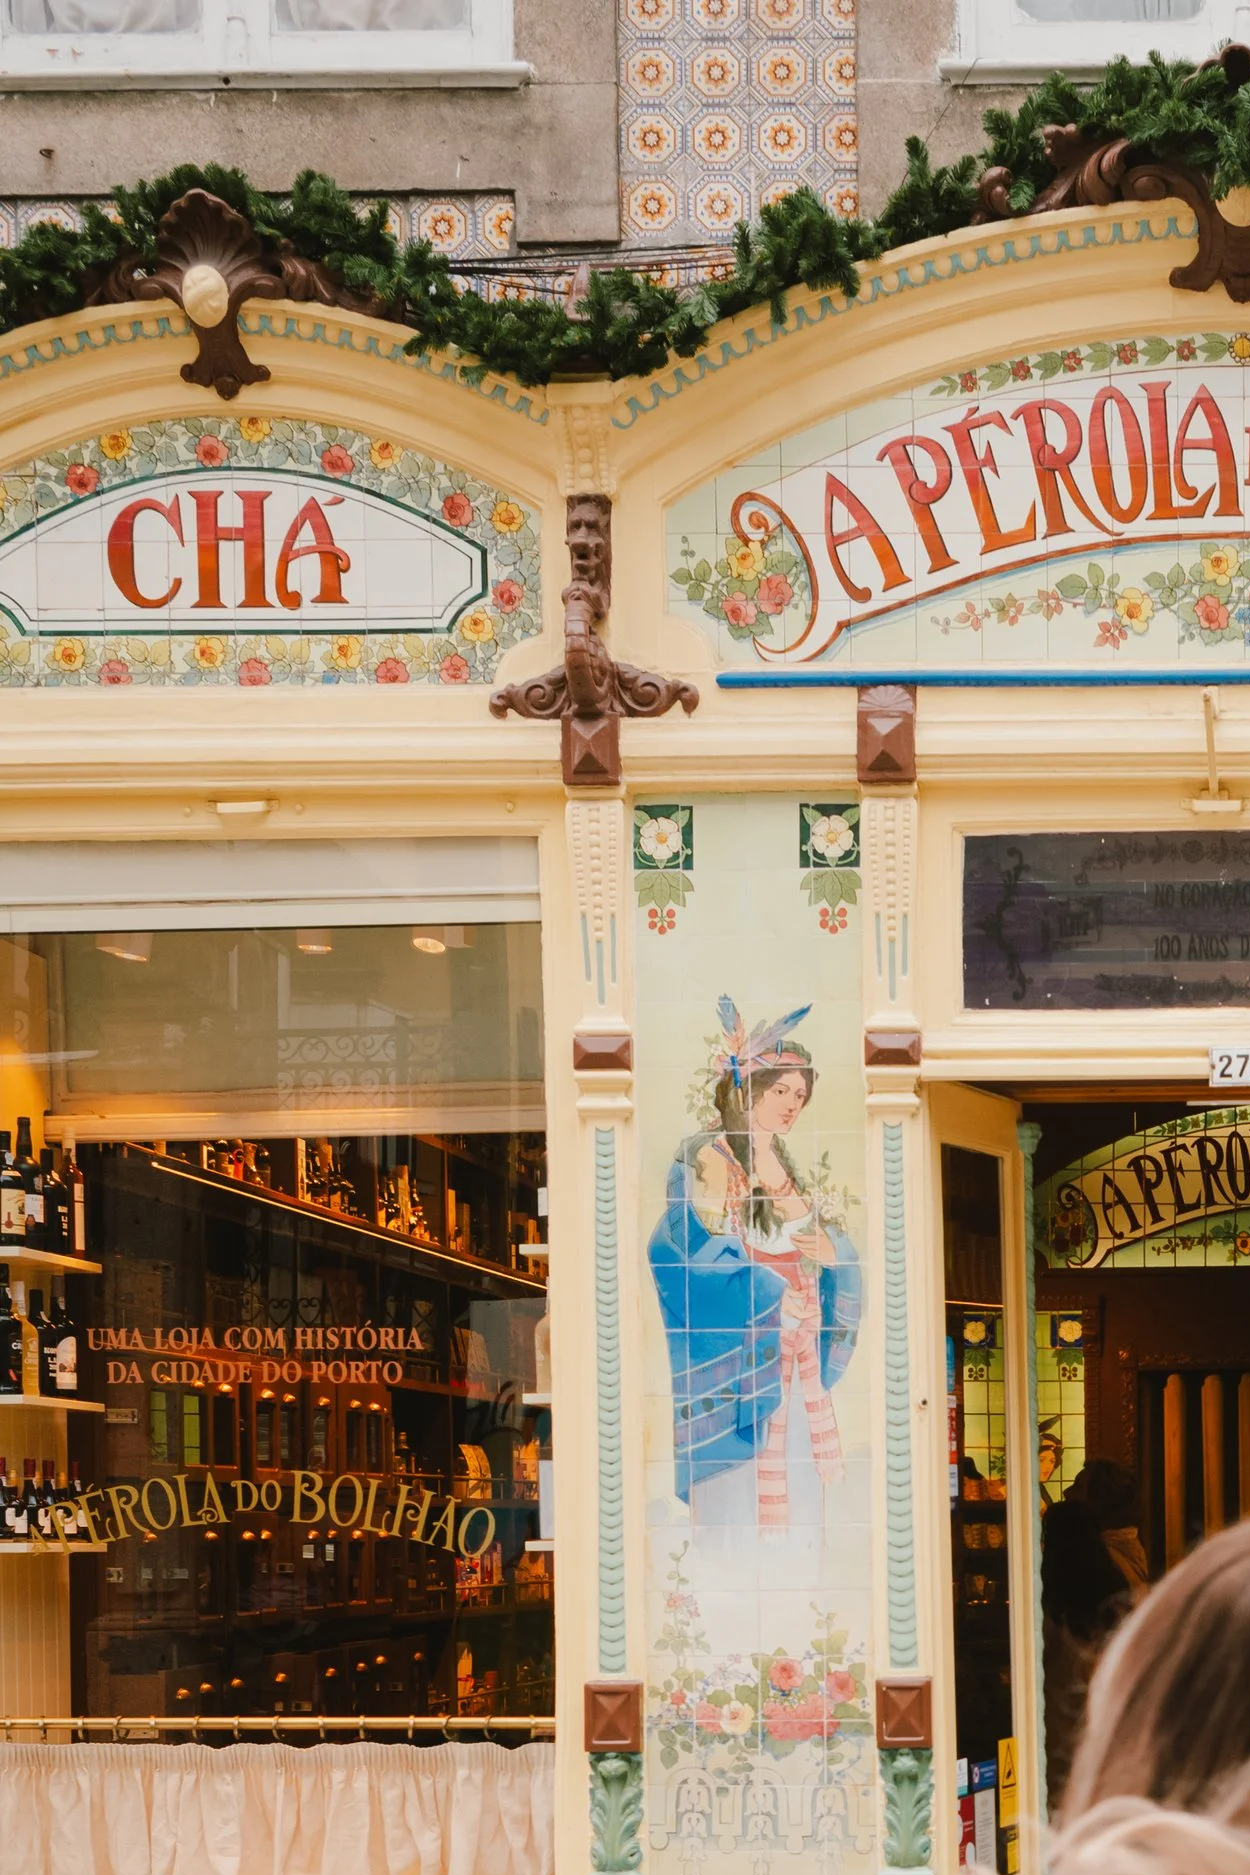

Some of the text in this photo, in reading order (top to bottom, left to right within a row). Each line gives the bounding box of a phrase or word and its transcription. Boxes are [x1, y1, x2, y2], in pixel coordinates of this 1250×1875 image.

[824, 472, 912, 604] A
[876, 381, 1244, 574] PÉROLA
[107, 490, 350, 610] CHÁ
[1153, 884, 1176, 908] NO
[1154, 935, 1181, 960] 100
[1187, 933, 1230, 960] ANOS
[1101, 1171, 1144, 1240] A
[87, 1320, 424, 1355] UMA LOJA COM HISTÓRIA
[107, 1360, 403, 1384] DA CIDADE DO PORTO
[29, 1469, 497, 1559] A PÉROLA DO BOLHÃO
